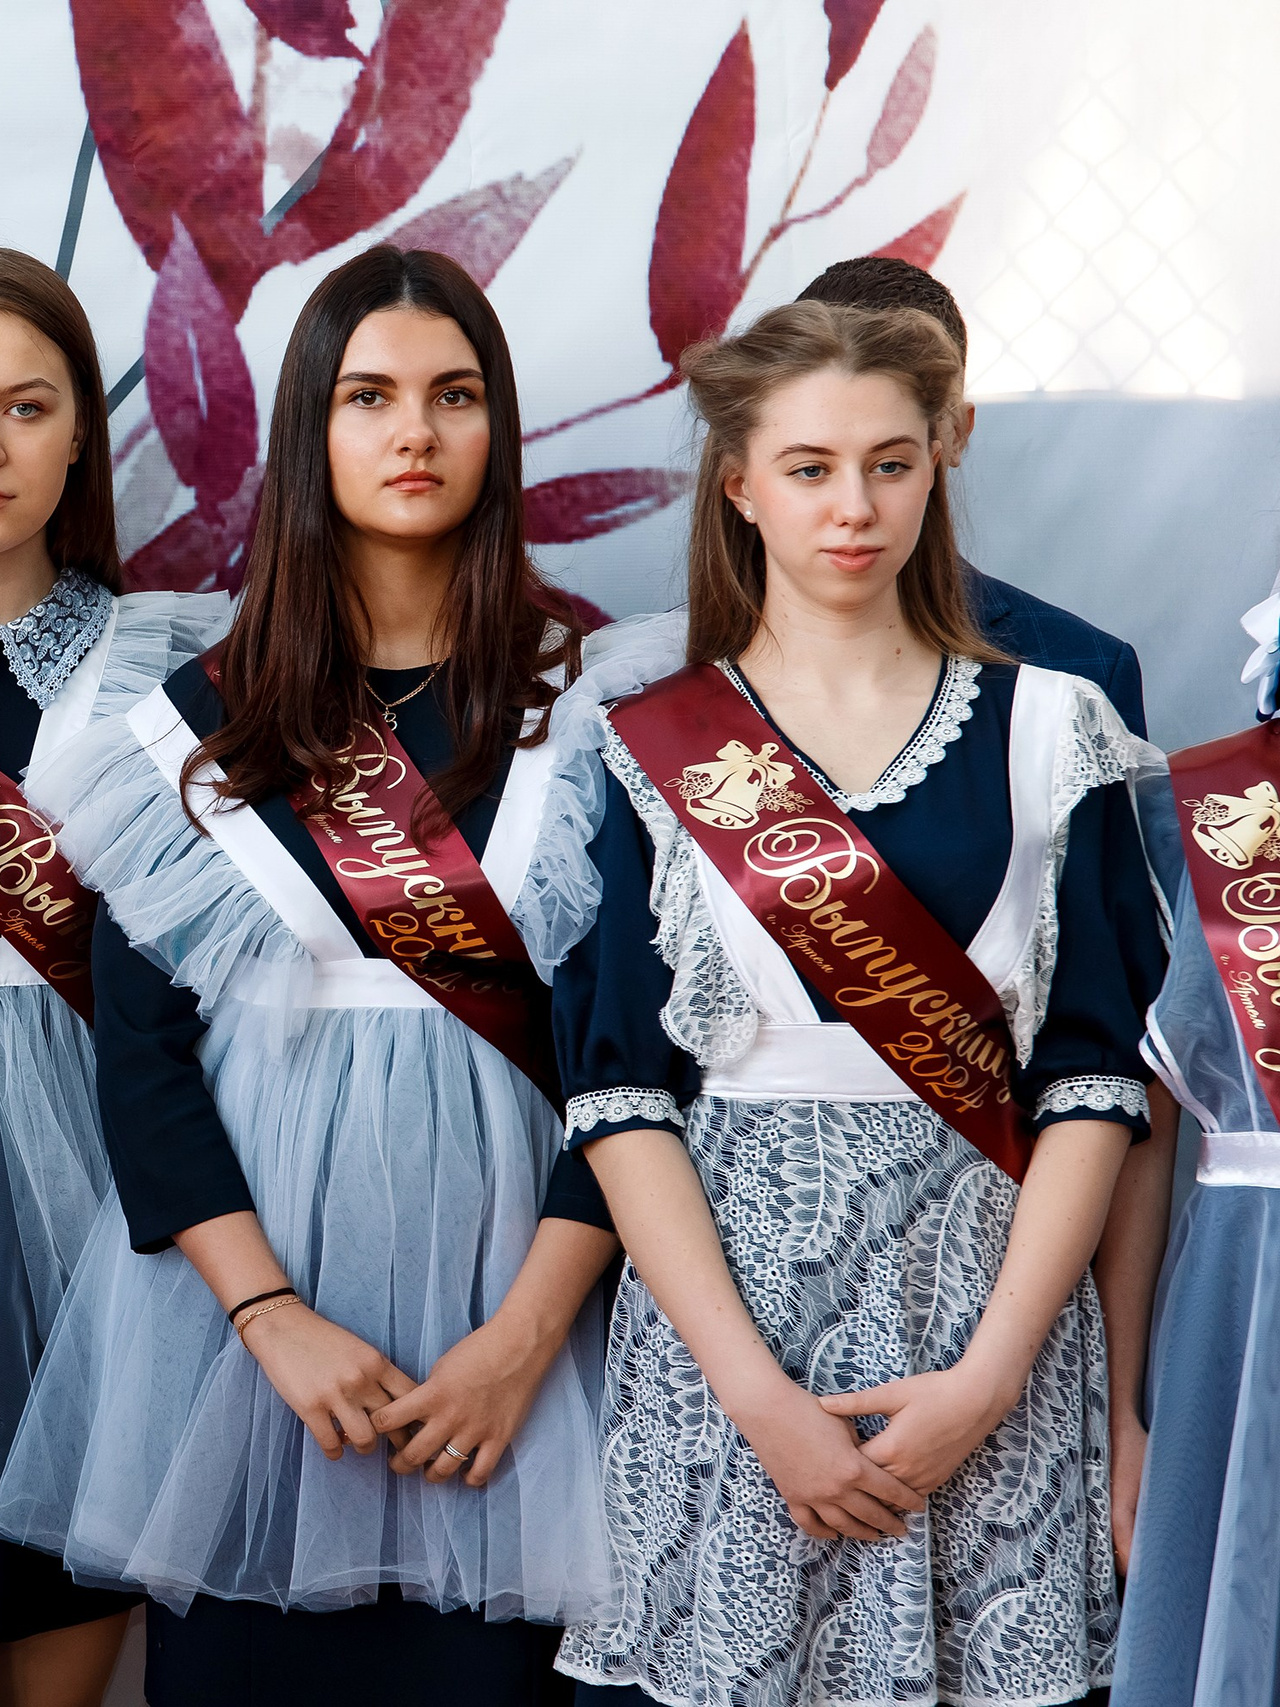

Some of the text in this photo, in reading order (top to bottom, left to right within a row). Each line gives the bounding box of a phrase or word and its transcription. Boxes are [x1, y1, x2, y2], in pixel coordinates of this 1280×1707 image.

[781, 924, 834, 974] Артем
[1229, 969, 1267, 1030] Артем
[882, 1030, 985, 1113] 2024
